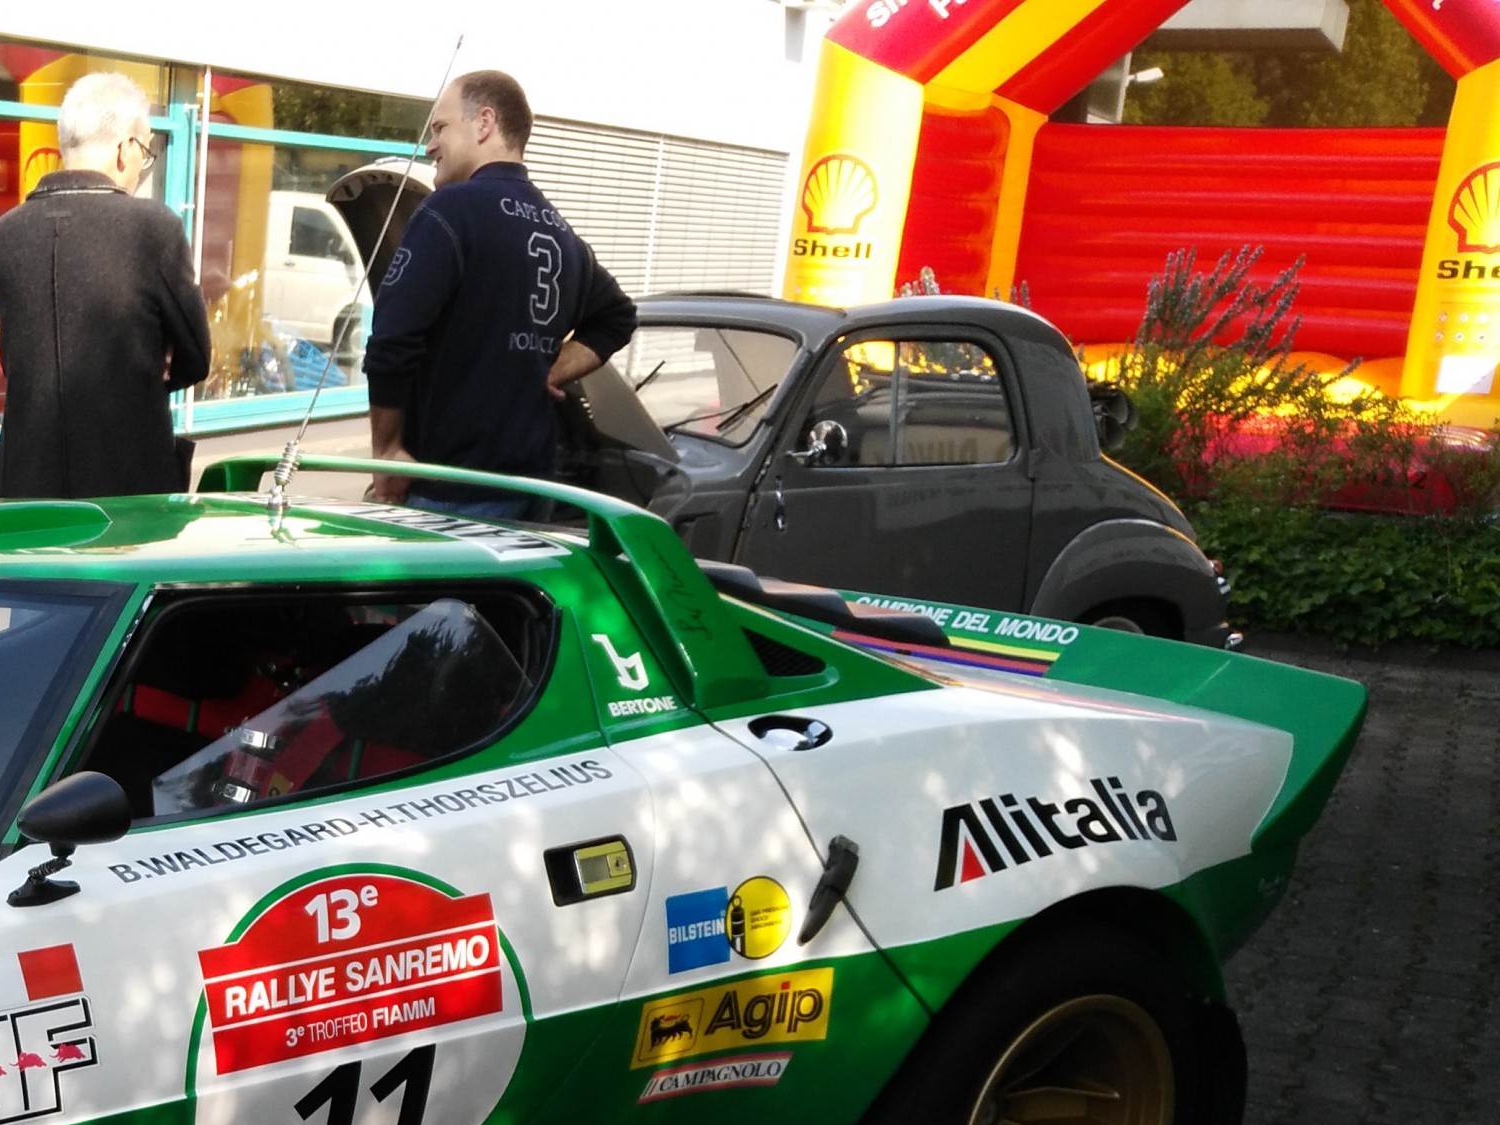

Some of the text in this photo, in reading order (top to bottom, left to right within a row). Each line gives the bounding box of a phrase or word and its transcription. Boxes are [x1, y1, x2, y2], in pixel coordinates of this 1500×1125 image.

[500, 198, 540, 223] CAPE
[793, 238, 872, 259] Shell
[528, 231, 563, 325] 3
[951, 611, 990, 633] DEL
[993, 617, 1079, 645] MONDO
[607, 695, 678, 717] BERTONE
[934, 776, 1178, 892] Alitalia
[669, 917, 726, 945] BILSTEIN
[225, 934, 490, 1019] RALLYE SANREMO
[307, 1012, 368, 1043] TROFFEO
[372, 997, 436, 1029] FIAMM
[704, 980, 824, 1040] Agip
[659, 1060, 782, 1092] CAMPAGNOLO
